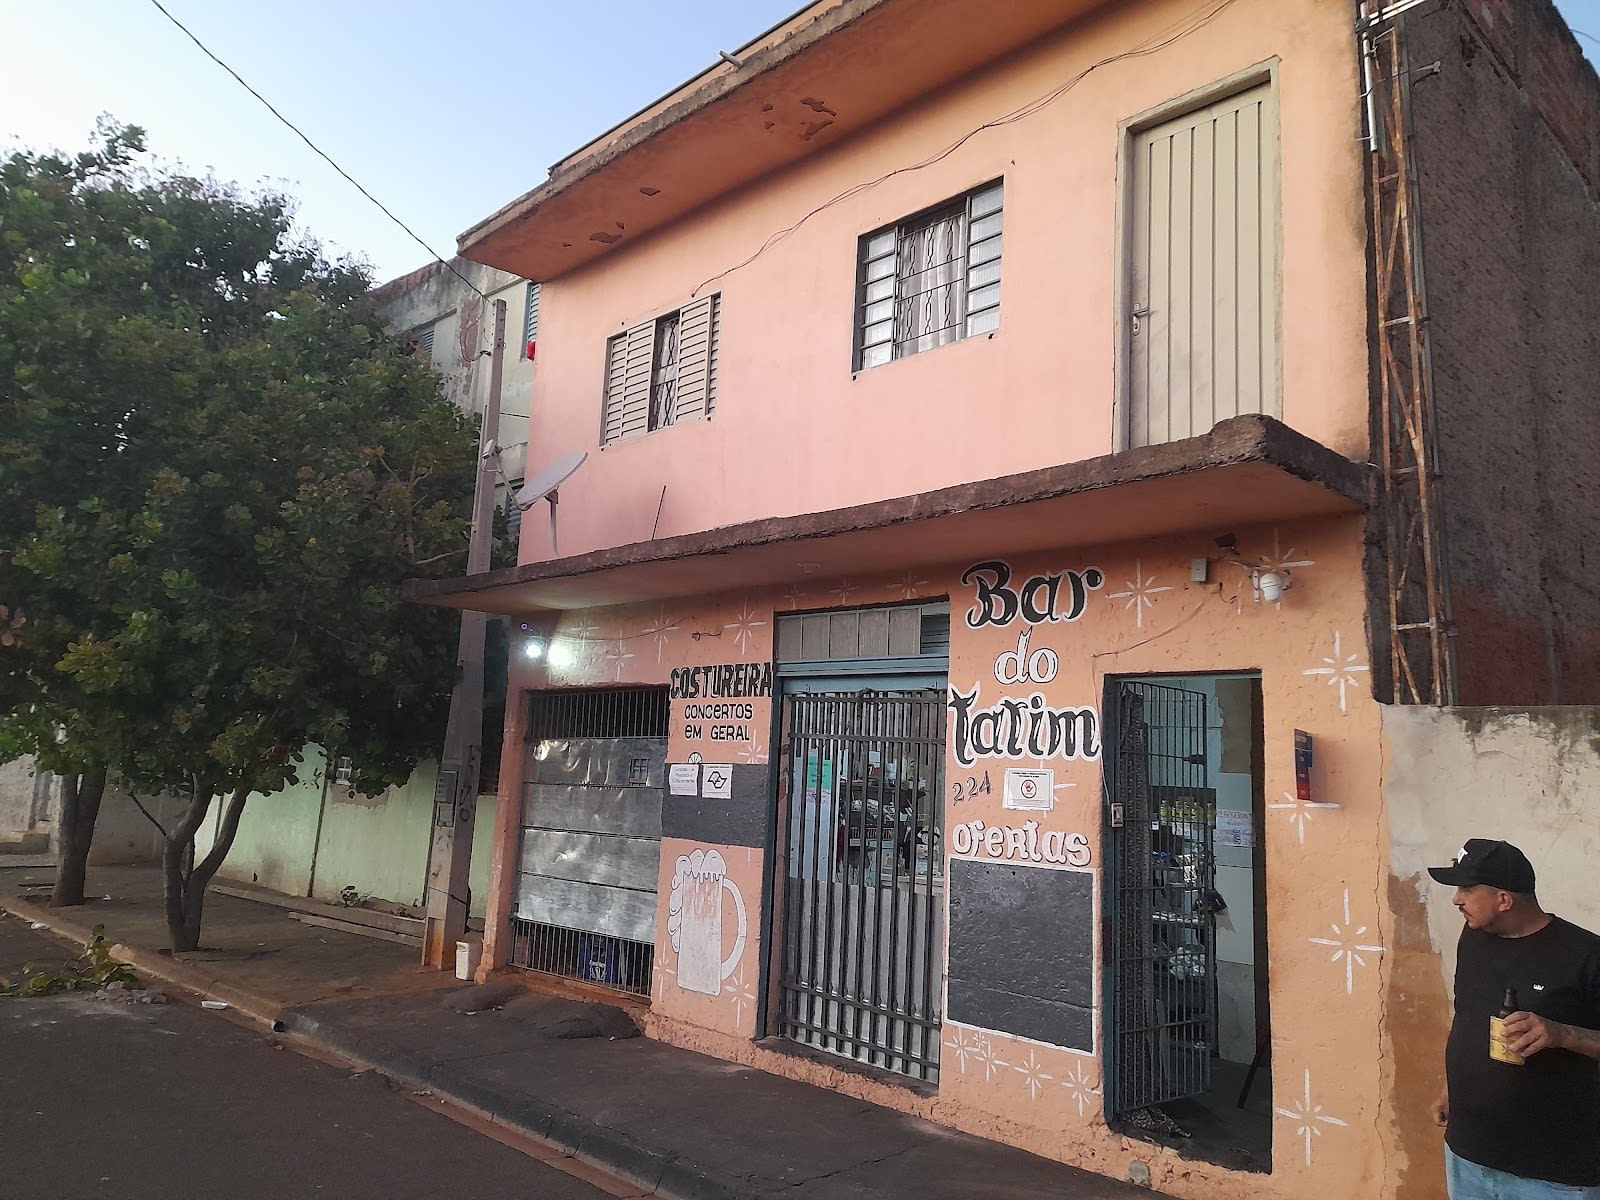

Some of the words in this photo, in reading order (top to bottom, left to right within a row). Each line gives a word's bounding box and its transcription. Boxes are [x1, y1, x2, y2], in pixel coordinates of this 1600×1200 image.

[961, 559, 1105, 629] Bar
[993, 625, 1059, 685] do
[670, 662, 773, 698] COSTUREIRA
[710, 724, 751, 742] GERAL
[952, 770, 993, 806] 224
